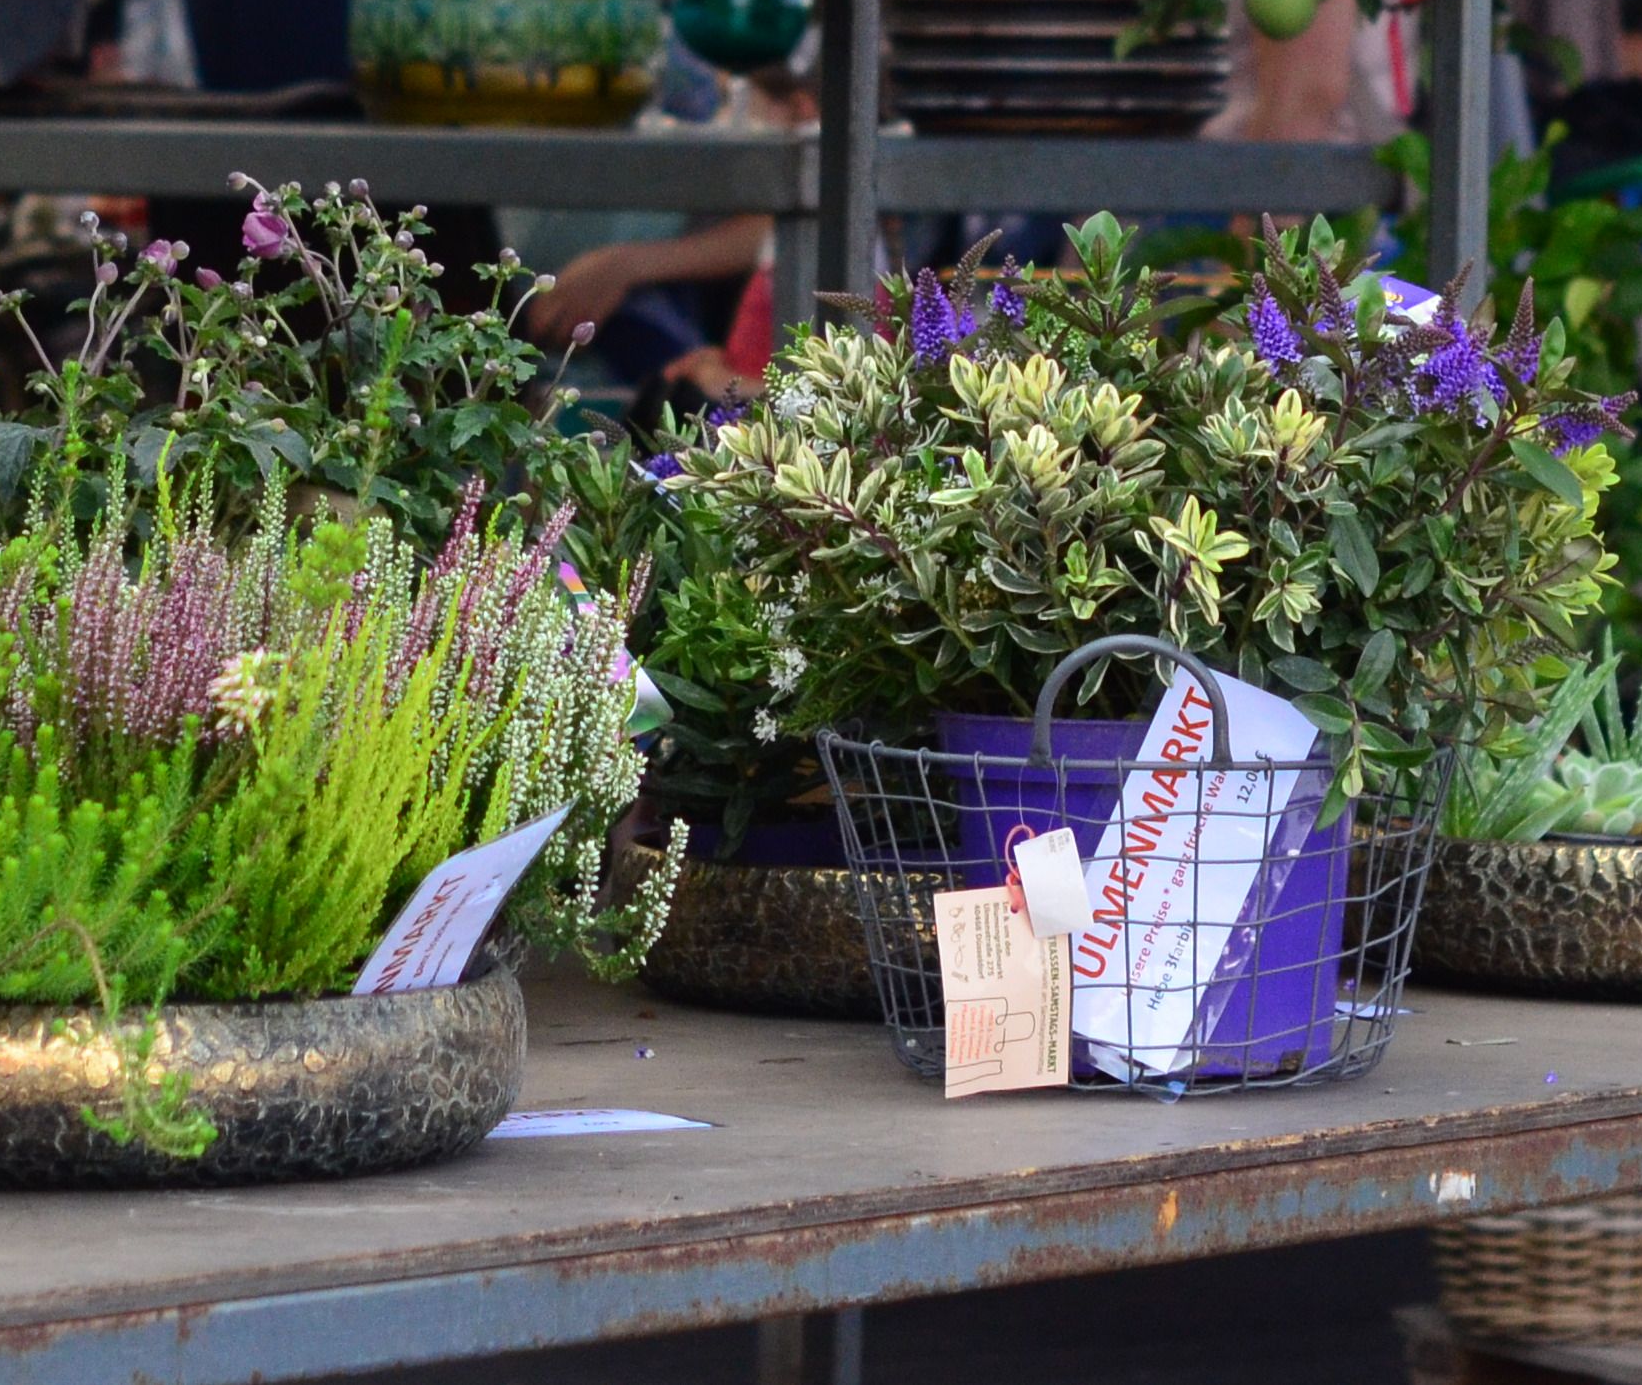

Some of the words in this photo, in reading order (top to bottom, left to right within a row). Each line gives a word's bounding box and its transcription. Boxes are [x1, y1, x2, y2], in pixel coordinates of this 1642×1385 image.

[1205, 765, 1228, 798] War
[1074, 686, 1214, 979] ULMENMARKT
[1147, 972, 1172, 1011] Hebe
